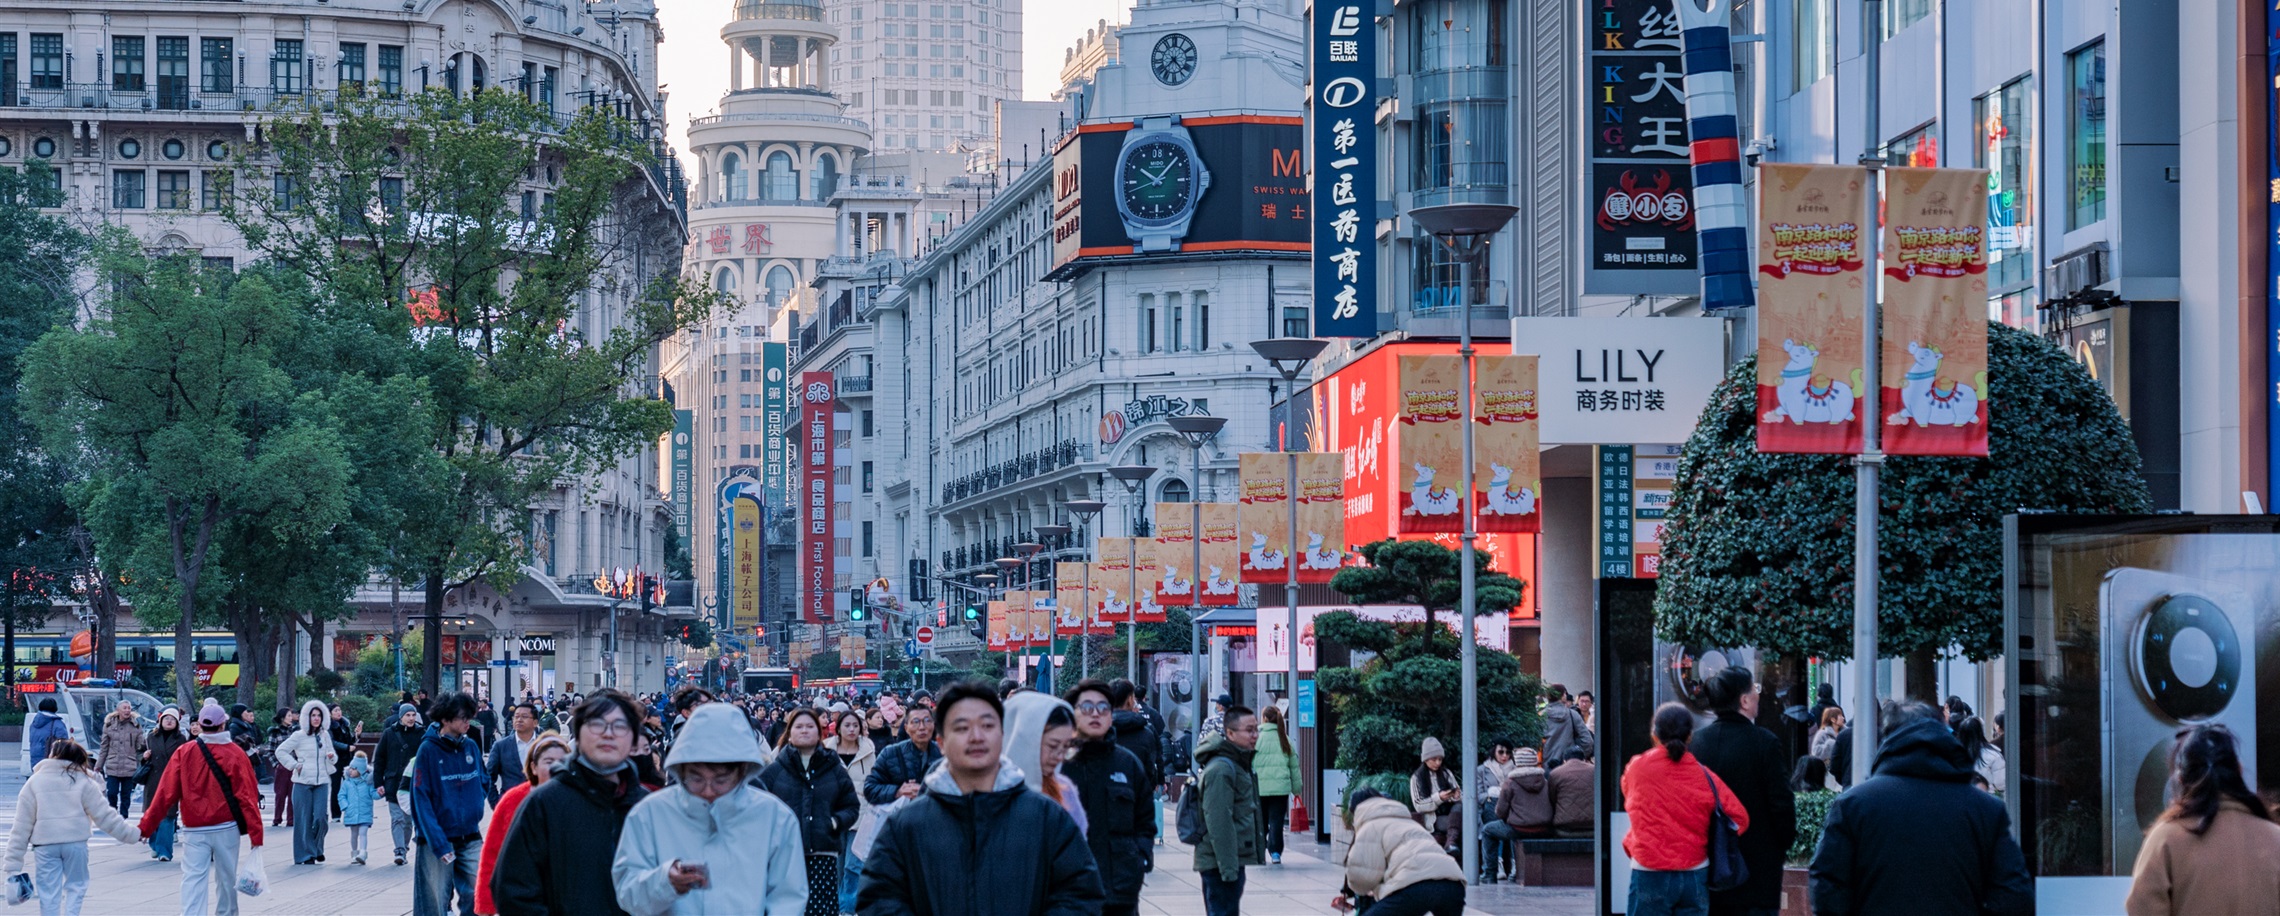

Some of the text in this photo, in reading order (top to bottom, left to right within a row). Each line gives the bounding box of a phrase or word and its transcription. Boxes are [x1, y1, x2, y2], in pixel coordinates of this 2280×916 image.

[1330, 41, 1358, 55] 百联
[1603, 65, 1625, 145] KING
[1152, 149, 1163, 158] 08
[1253, 186, 1285, 195] SWISS
[1609, 195, 1685, 217] 蟹小友
[1329, 118, 1361, 320] 第一医药商店
[1772, 223, 1857, 246] 南京路和你
[1896, 226, 1981, 249] 南京路和你
[1774, 240, 1856, 265] 一起迎新年
[1899, 244, 1980, 268] 一起迎新年
[1576, 349, 1665, 382] LILY
[1576, 389, 1665, 411] 商务时装
[811, 410, 826, 535] 上海市第一食品商店
[676, 449, 688, 537] 第一百货商业中心
[1603, 453, 1614, 556] 欧洲亚洲留学咨询
[1618, 453, 1629, 556] 德日法韩西语培训
[741, 539, 752, 611] 上海帐子公司
[813, 542, 825, 615] First Foodhall
[1607, 564, 1627, 575] 4楼
[56, 669, 76, 682] CITY
